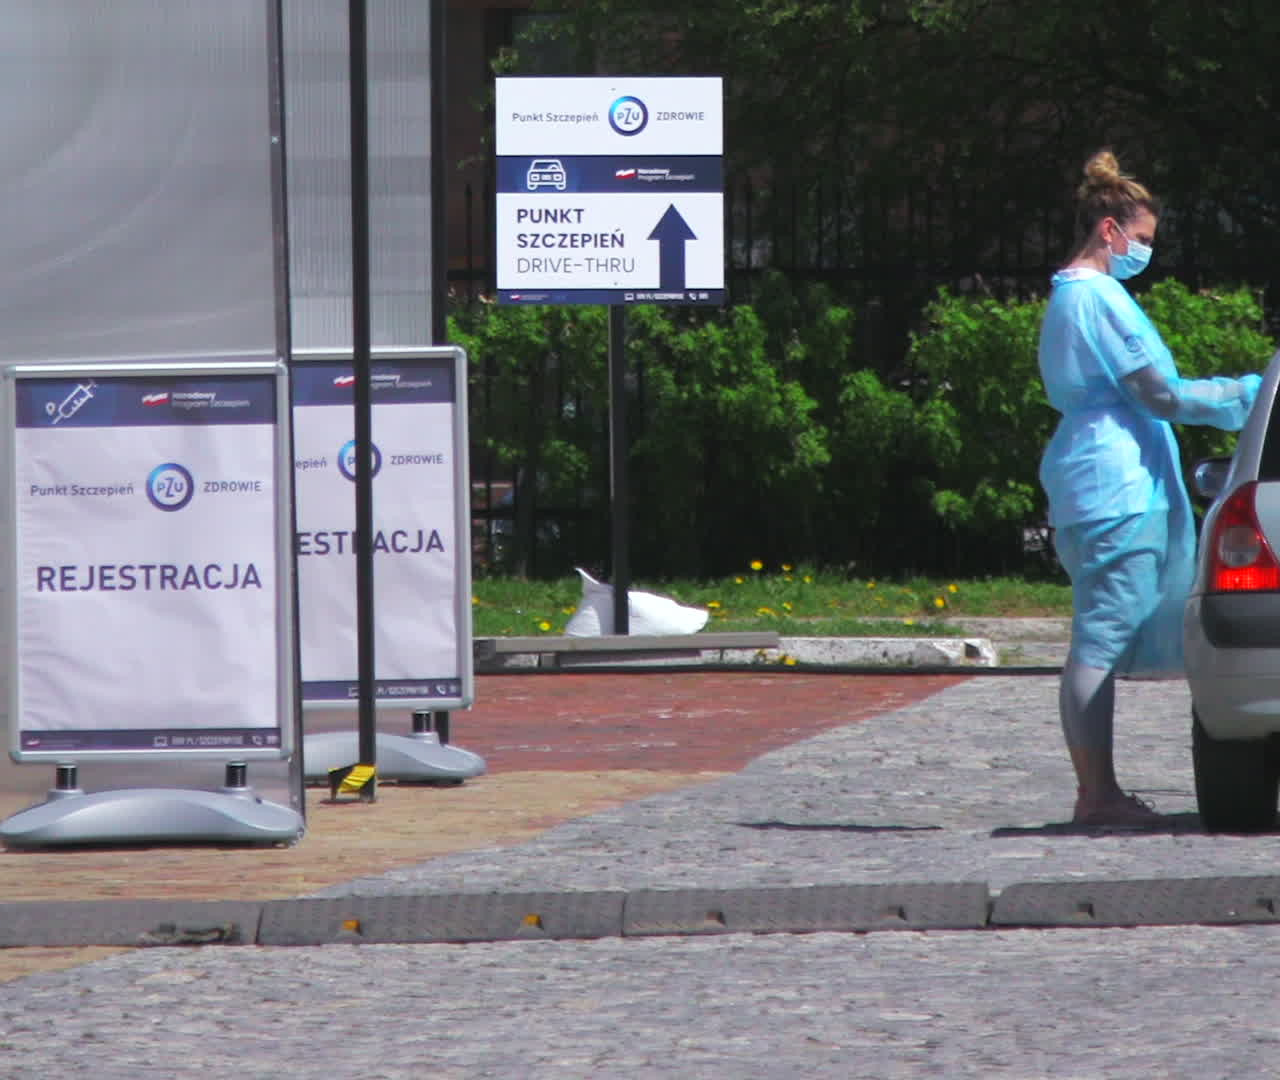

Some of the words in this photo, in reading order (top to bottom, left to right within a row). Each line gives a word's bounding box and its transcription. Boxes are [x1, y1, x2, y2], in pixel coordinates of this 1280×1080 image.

[512, 112, 544, 123] Punkt
[546, 112, 599, 125] Szczepień
[656, 111, 705, 122] ZDROWIE
[516, 208, 585, 224] PUNKT
[516, 228, 625, 248] SZCZEPIEŃ
[516, 257, 635, 273] DRIVE-THRU
[295, 457, 327, 470] epień
[390, 454, 444, 466] ZDROWIE
[30, 484, 67, 497] Punkt
[71, 482, 135, 497] Szczepień
[203, 481, 262, 493] ZDROWIE
[296, 529, 445, 556] ESTACJA
[36, 563, 262, 592] REJESTRACJA
